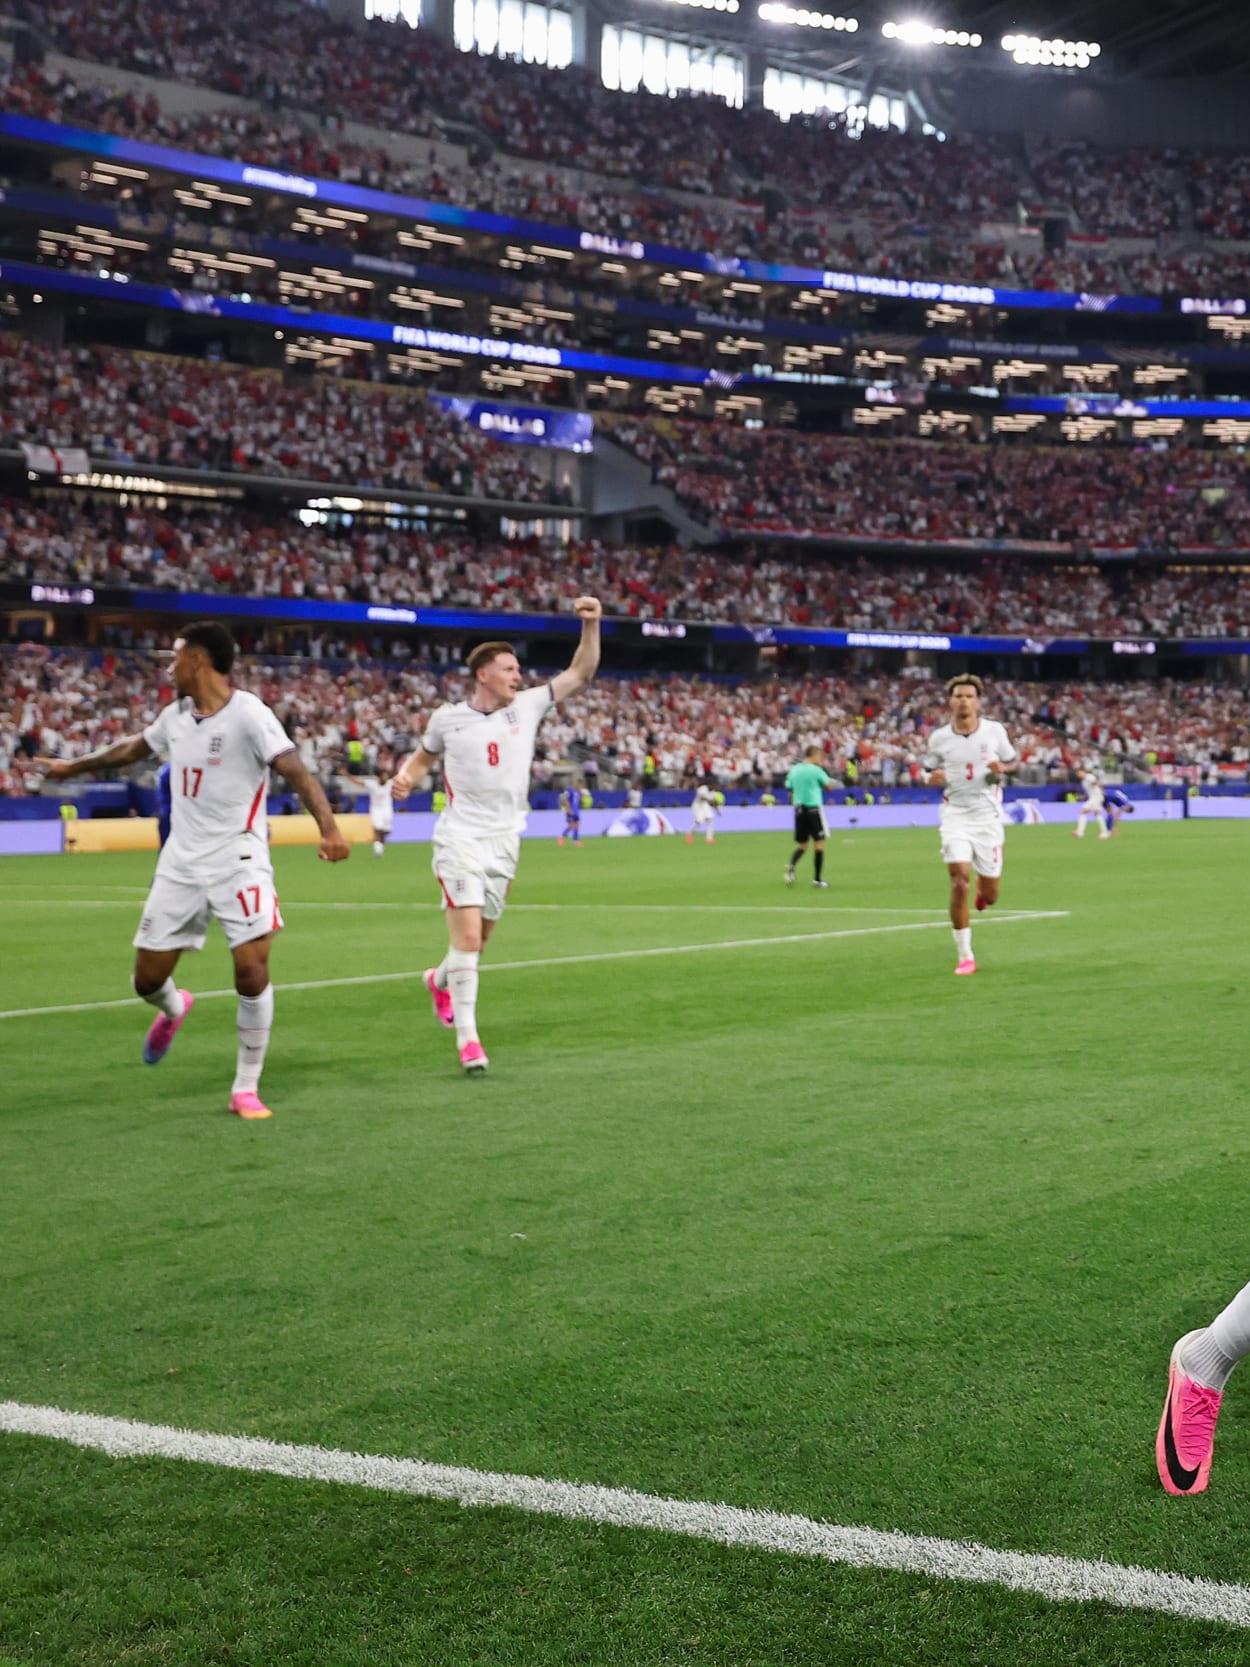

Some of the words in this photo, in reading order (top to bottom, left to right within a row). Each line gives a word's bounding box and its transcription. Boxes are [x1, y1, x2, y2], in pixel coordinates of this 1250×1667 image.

[823, 271, 857, 292] FIFA
[857, 276, 910, 298] WORLD
[910, 283, 942, 300] CUP
[942, 285, 996, 305] 2026
[487, 742, 500, 767] 8
[182, 766, 203, 798] 17
[965, 763, 974, 780] 3
[236, 885, 261, 917] 17
